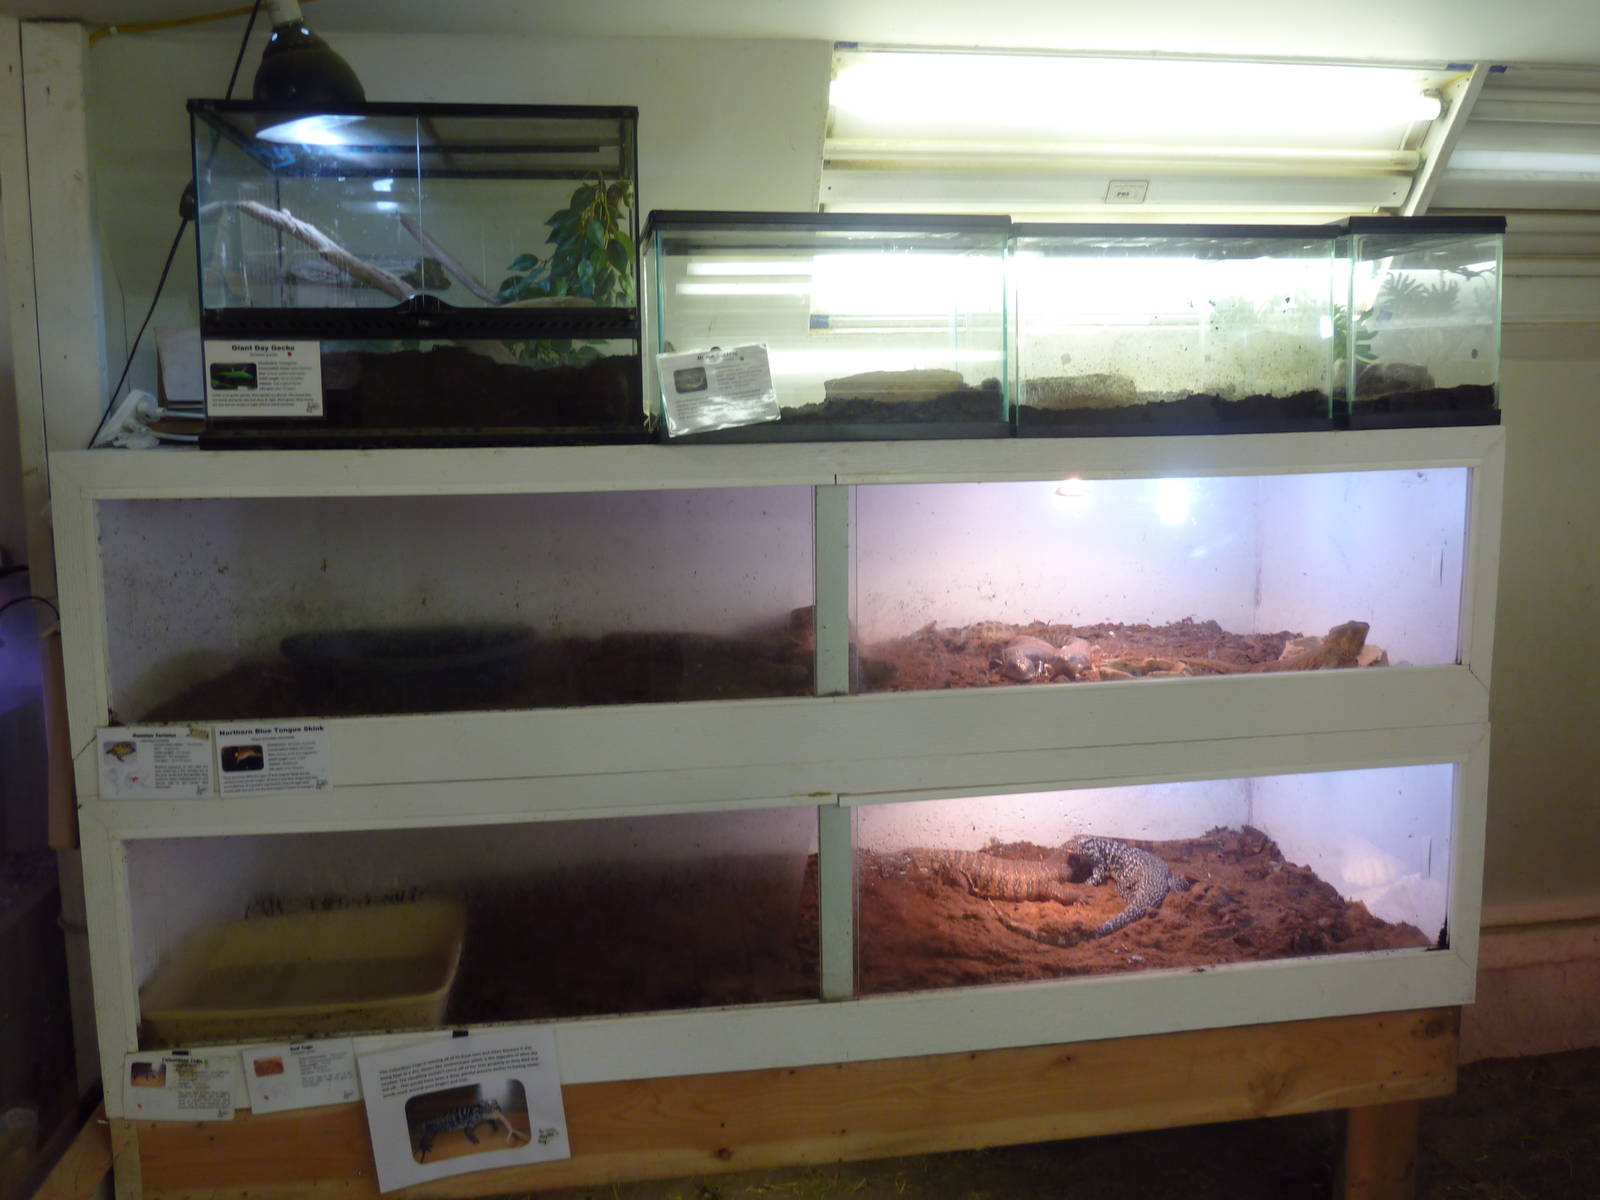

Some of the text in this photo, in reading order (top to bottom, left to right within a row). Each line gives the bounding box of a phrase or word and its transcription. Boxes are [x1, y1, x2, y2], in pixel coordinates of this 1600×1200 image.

[254, 344, 269, 353] Day
[219, 724, 324, 737] Northern Blue Tongue Skink
